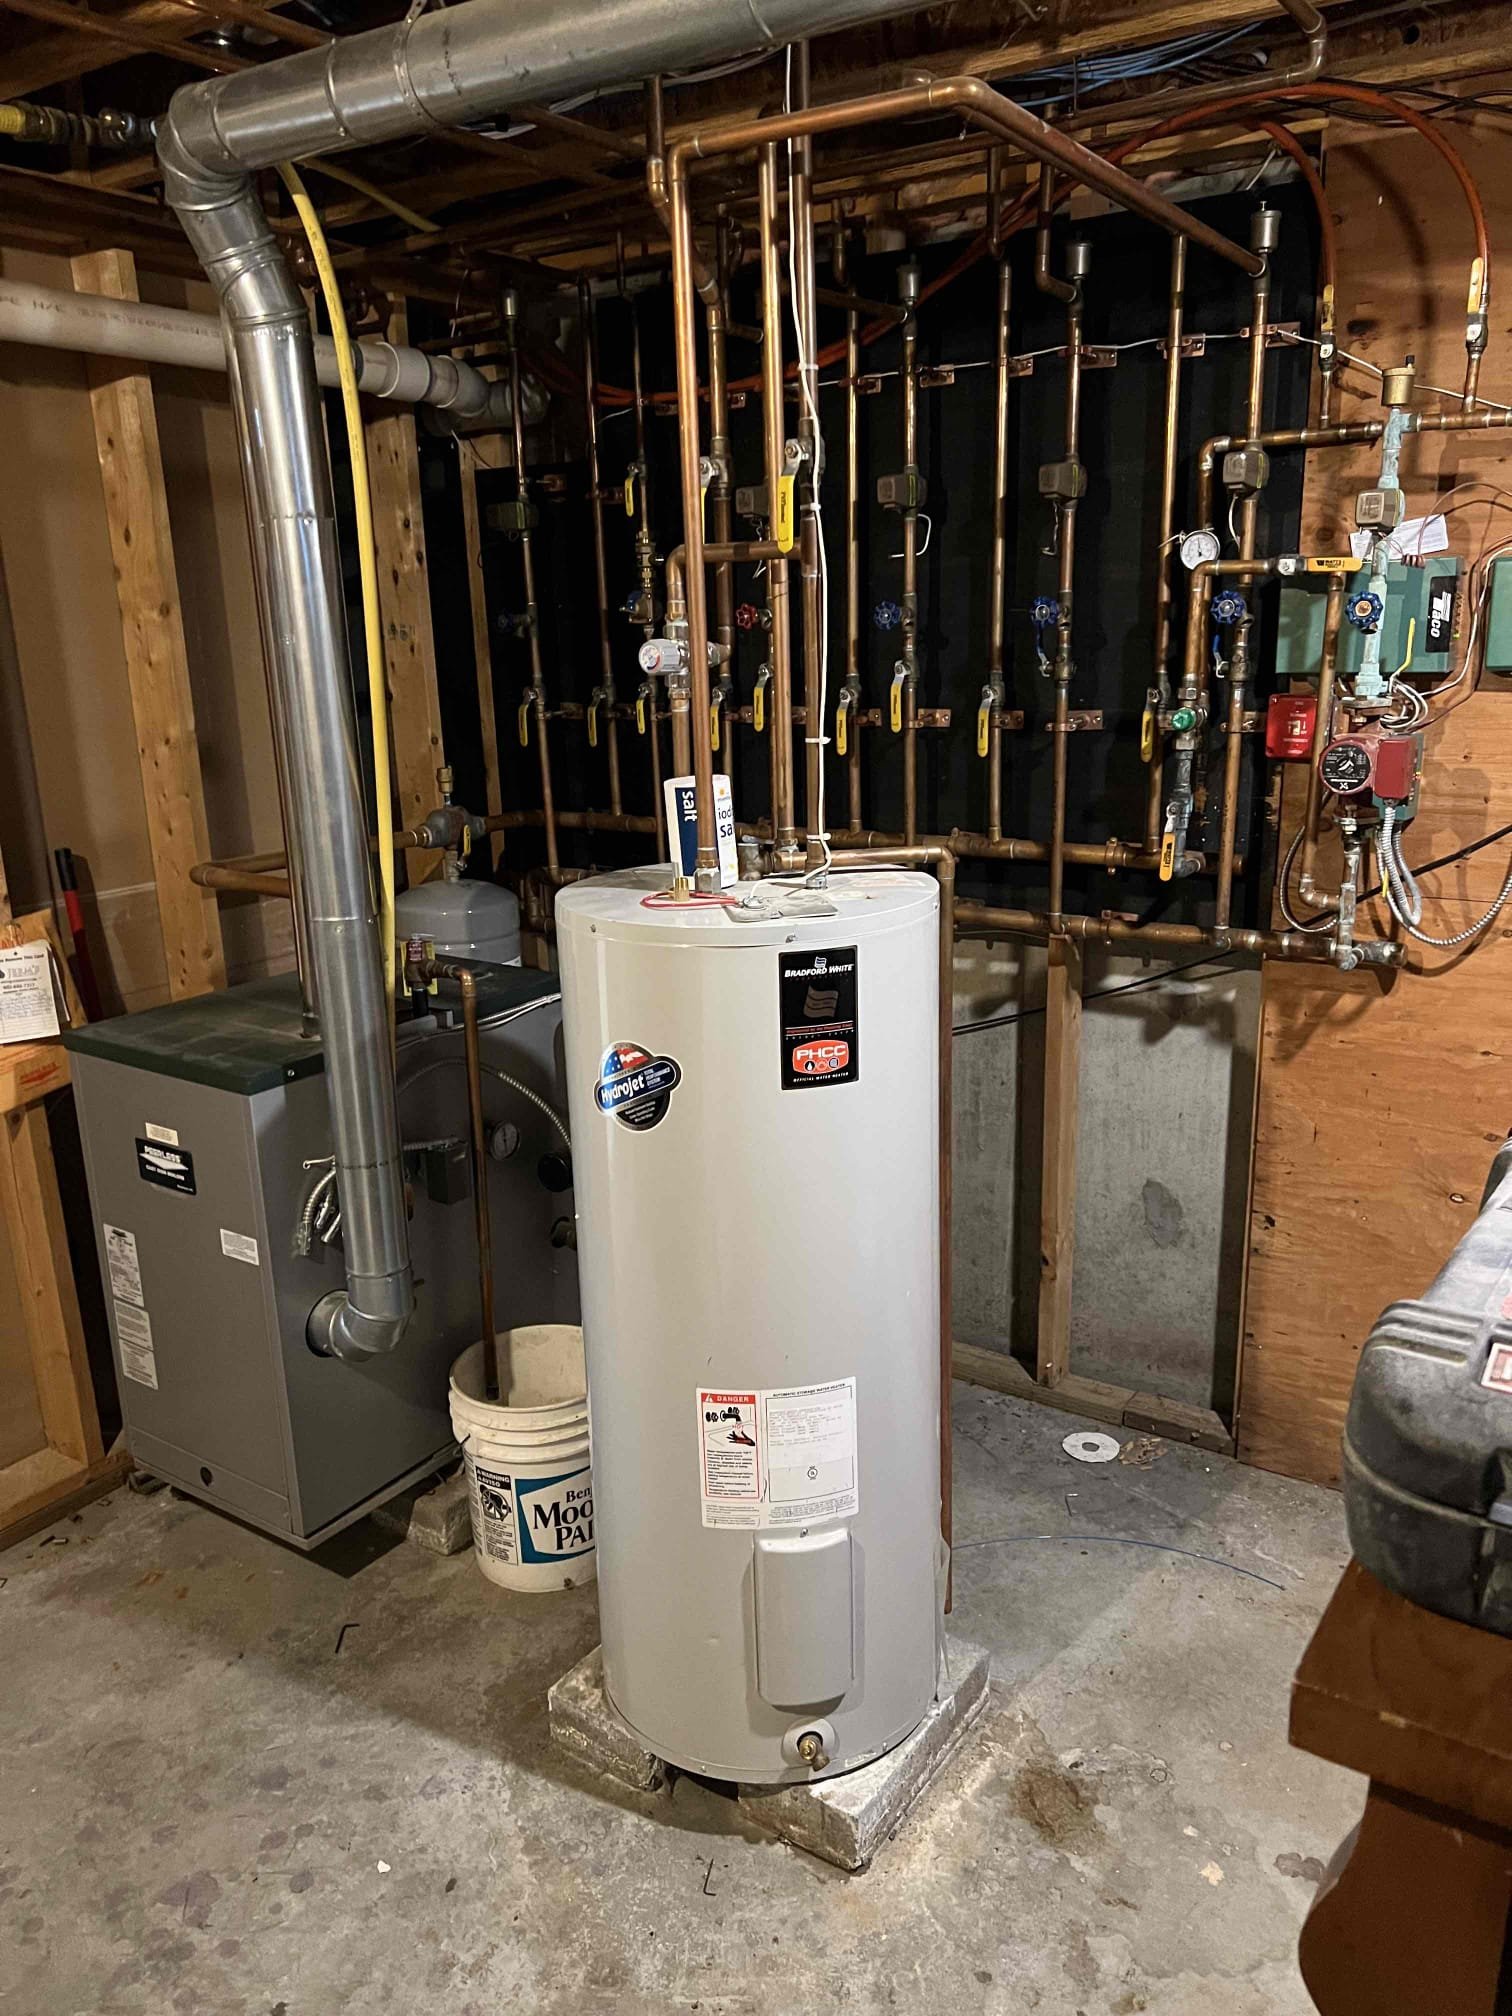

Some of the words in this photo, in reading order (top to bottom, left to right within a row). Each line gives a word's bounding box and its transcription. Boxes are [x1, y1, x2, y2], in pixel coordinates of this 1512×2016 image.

[1430, 591, 1452, 638] Taco
[682, 790, 698, 822] salt
[784, 967, 828, 978] BRADFORD
[828, 963, 853, 974] WHITE
[796, 1044, 846, 1061] PHCC
[601, 1074, 645, 1105] Hydrojet
[481, 1470, 511, 1483] WARNING
